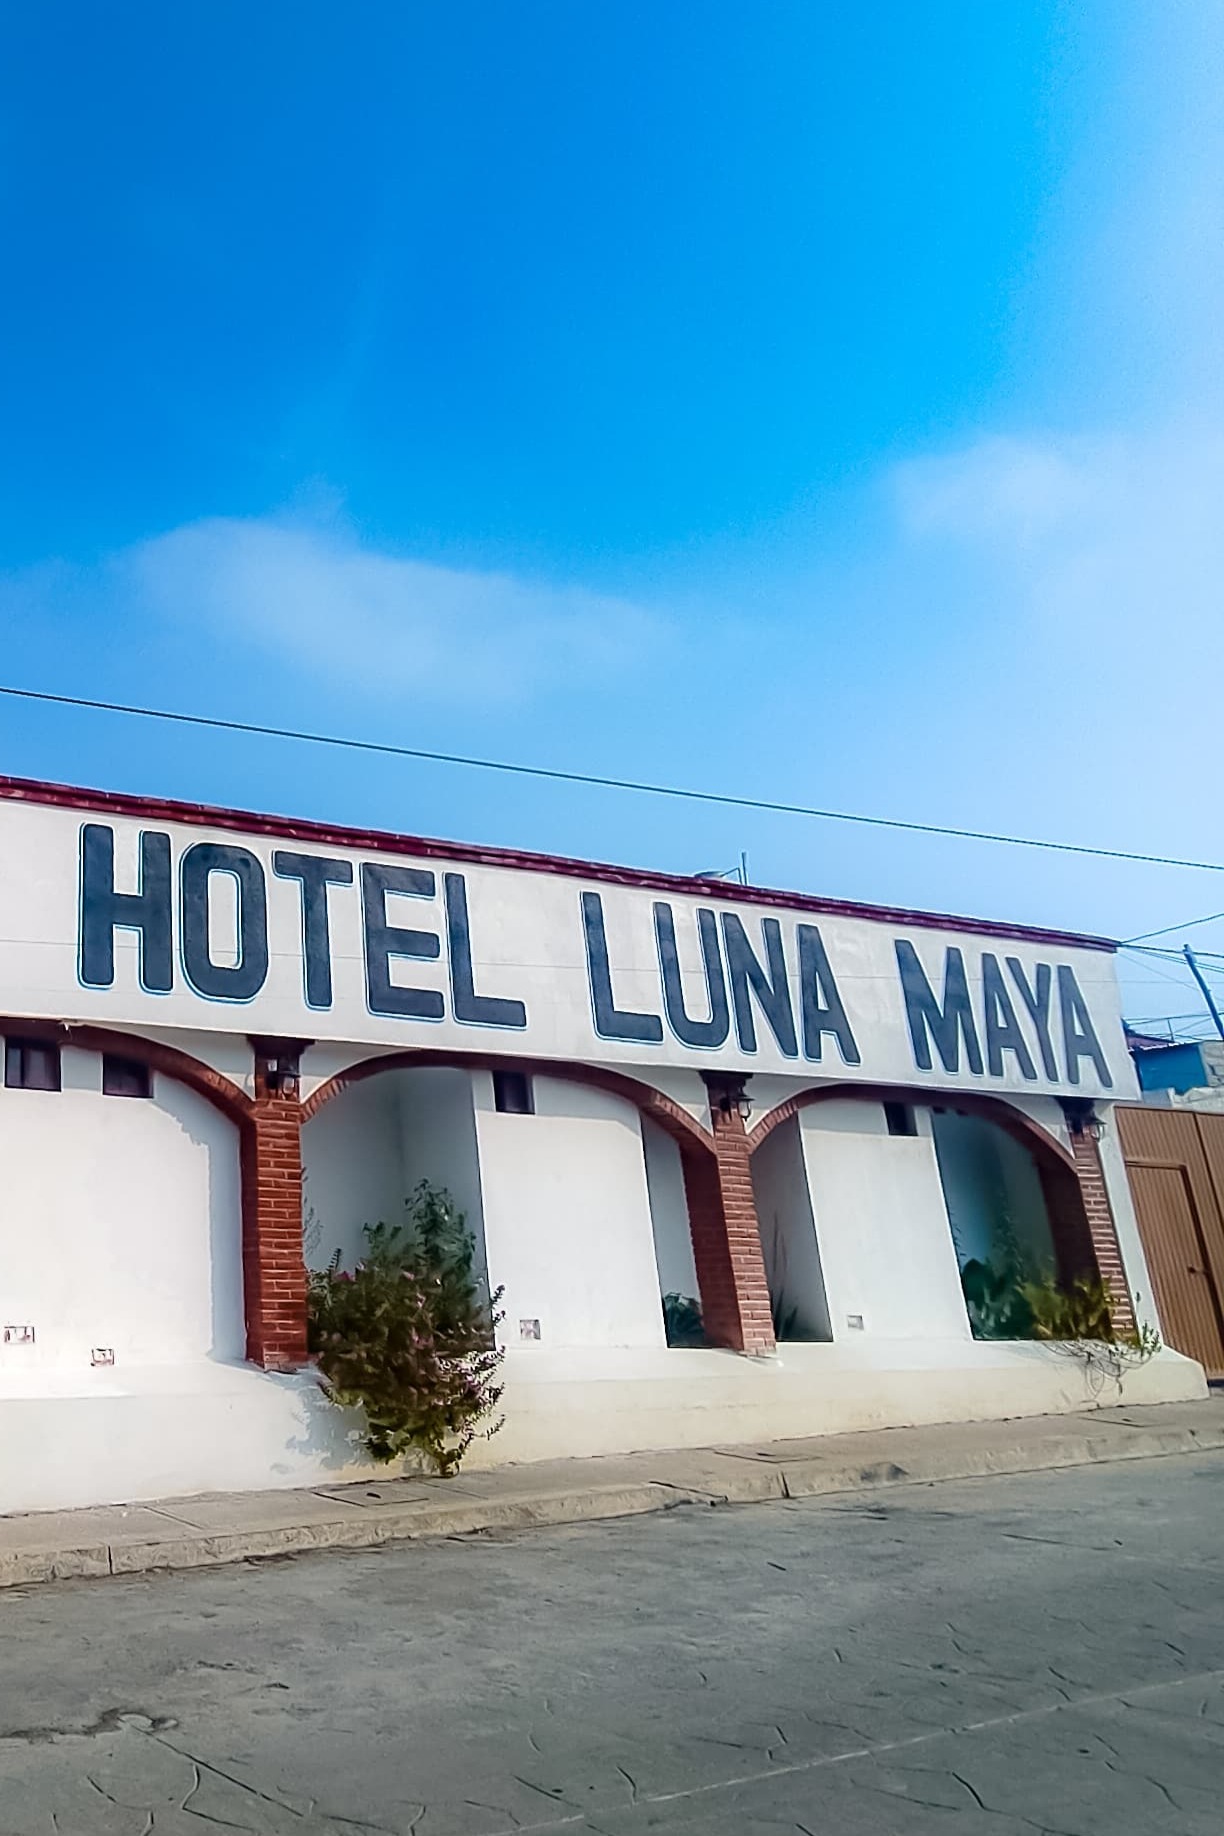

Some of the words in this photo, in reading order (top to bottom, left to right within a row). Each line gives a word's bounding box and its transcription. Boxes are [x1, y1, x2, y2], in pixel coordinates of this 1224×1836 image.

[78, 822, 528, 1030] HOTEL
[579, 890, 861, 1066] LUNA
[893, 938, 1114, 1089] MAYA
